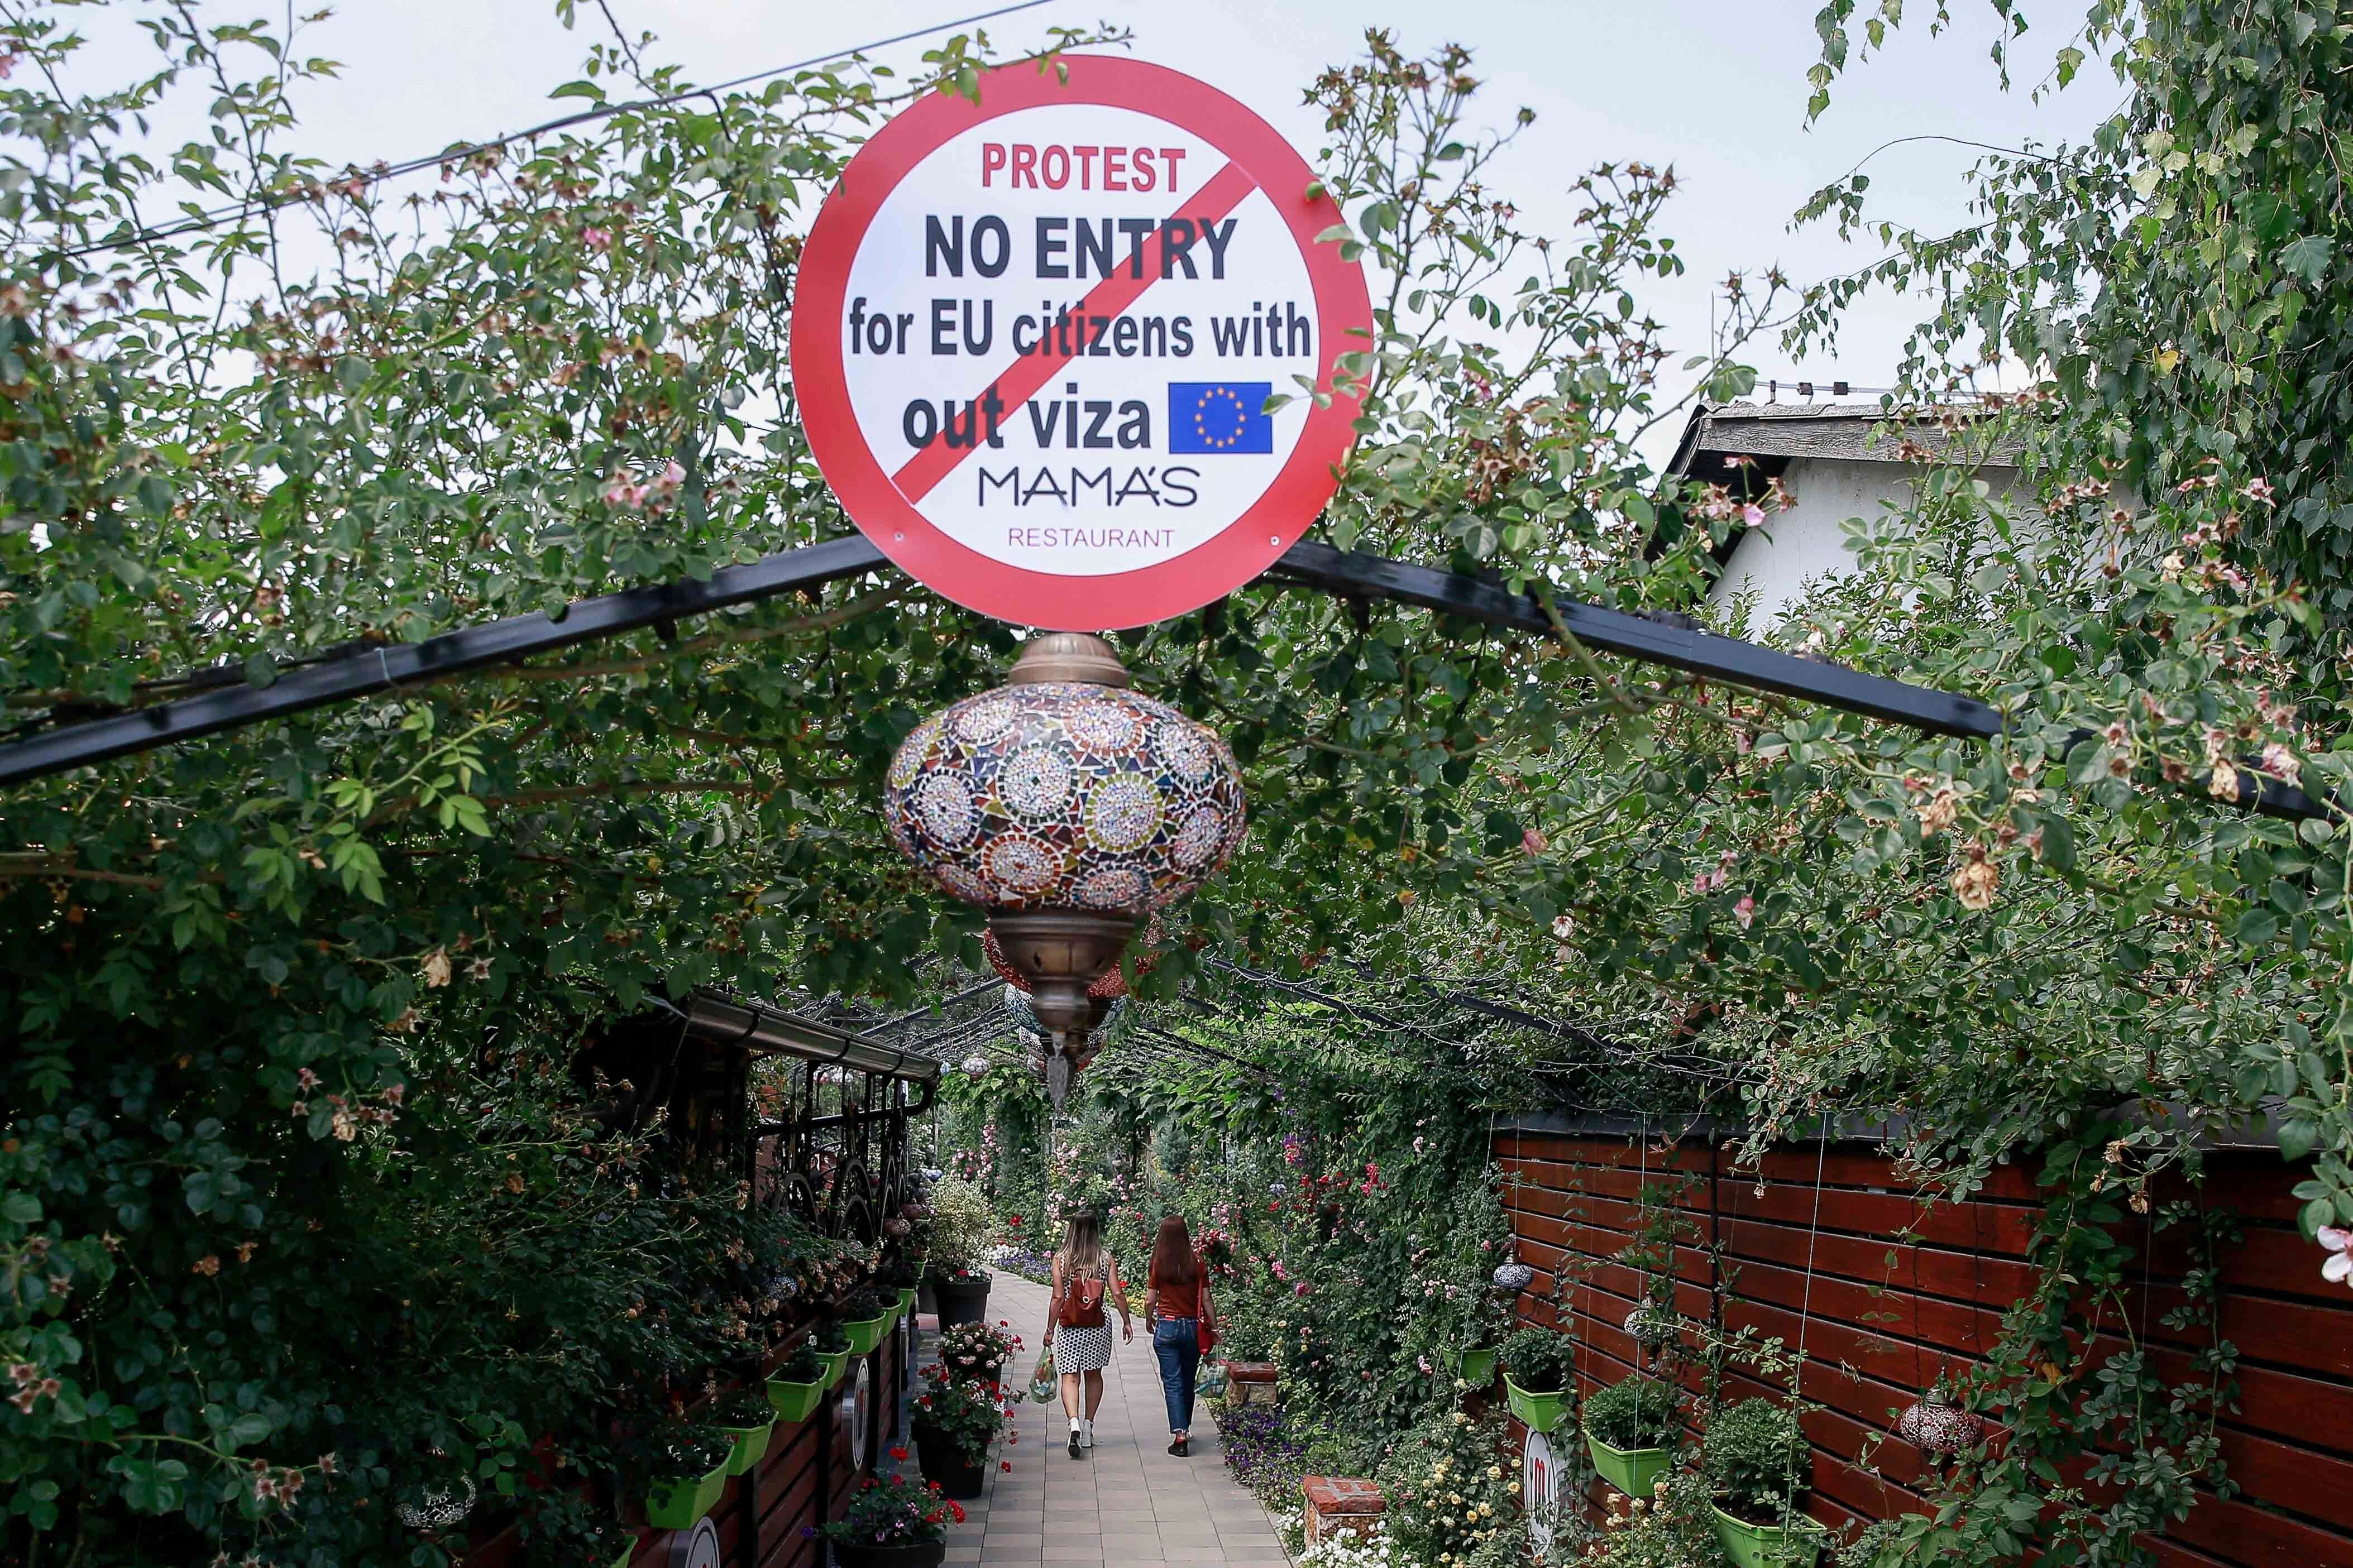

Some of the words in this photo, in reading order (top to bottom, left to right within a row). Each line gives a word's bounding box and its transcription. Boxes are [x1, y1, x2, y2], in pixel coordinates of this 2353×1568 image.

[983, 143, 1185, 192] PROTEST
[926, 215, 1010, 278] NO
[1036, 217, 1237, 280] ENTRY
[849, 298, 914, 354] for
[931, 299, 992, 356] EU
[1013, 299, 1193, 357] citizens
[1211, 301, 1311, 357] with
[903, 383, 1004, 449] out
[1027, 383, 1151, 449] viza
[1009, 528, 1174, 548] RESTAURANT
